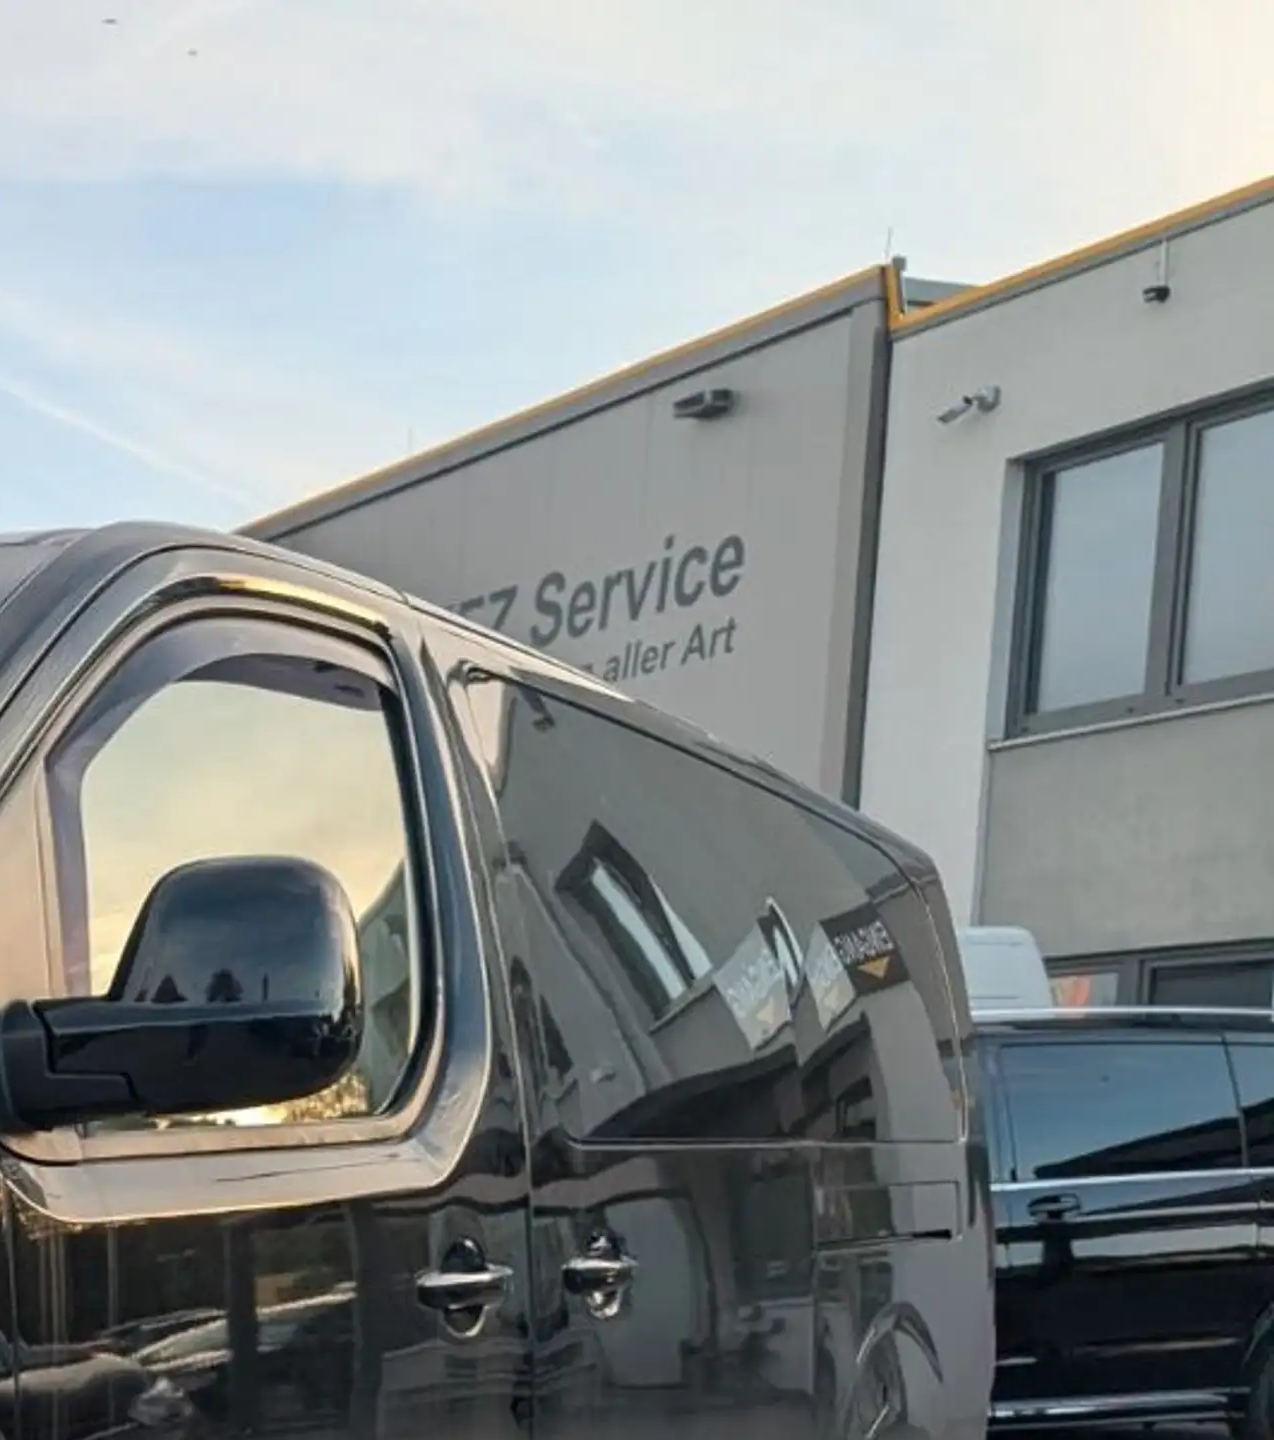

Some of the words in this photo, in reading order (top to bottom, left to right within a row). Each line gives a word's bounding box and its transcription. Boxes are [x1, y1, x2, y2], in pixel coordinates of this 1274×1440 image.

[530, 533, 745, 649] Service
[603, 640, 676, 683] aller
[680, 616, 738, 666] Art
